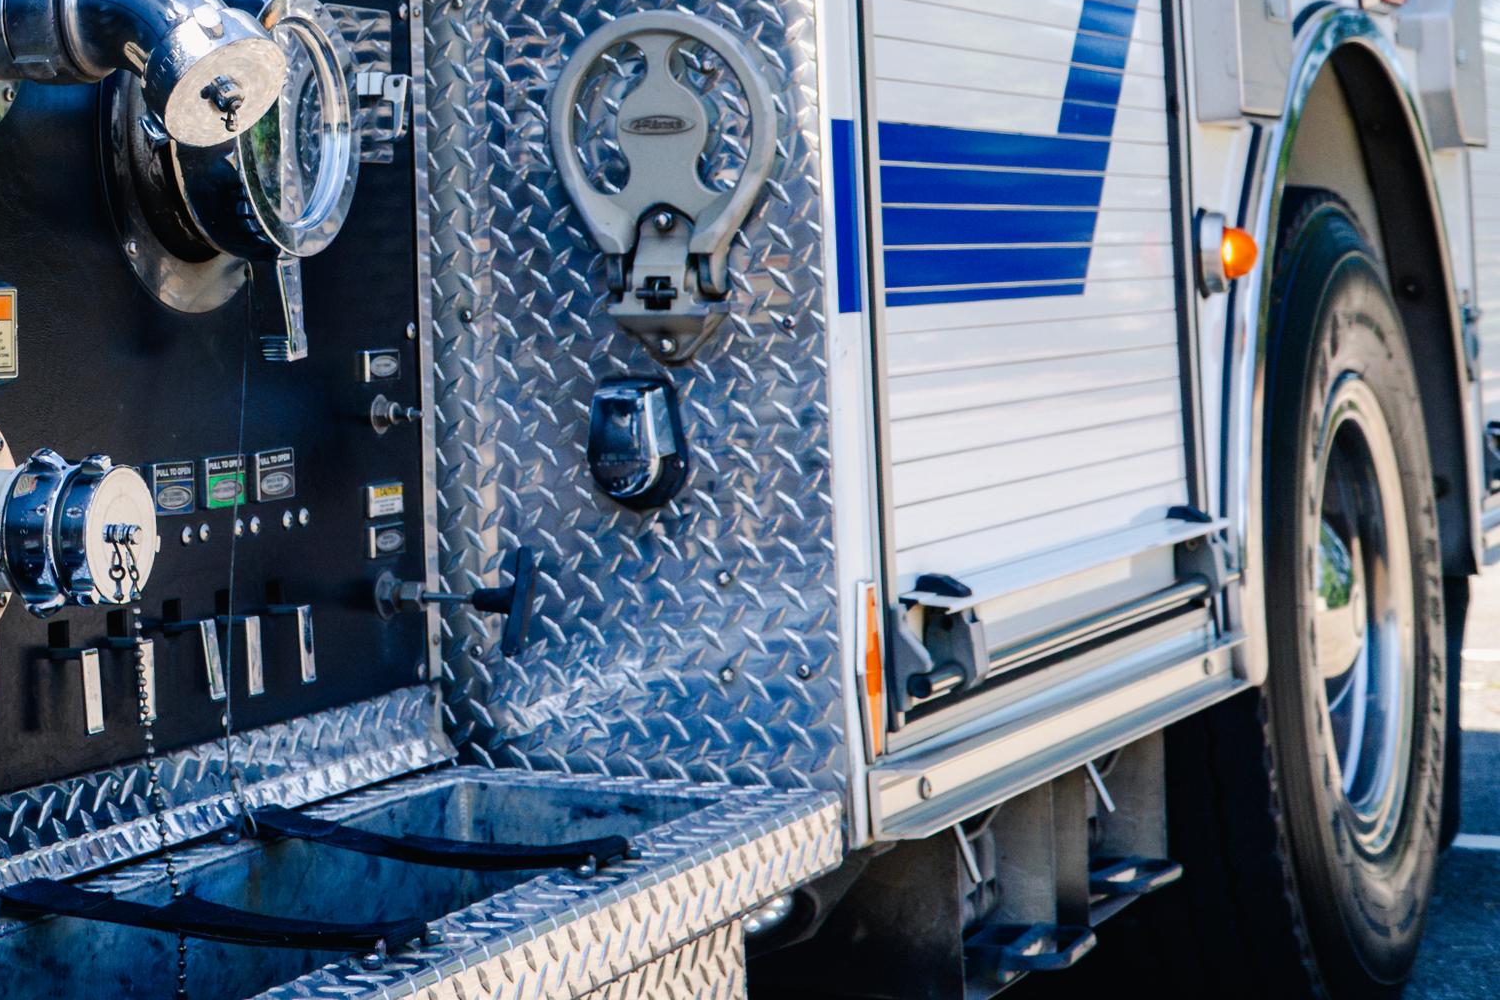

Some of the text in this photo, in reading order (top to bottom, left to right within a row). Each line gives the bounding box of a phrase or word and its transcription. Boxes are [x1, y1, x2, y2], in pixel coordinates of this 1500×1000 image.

[270, 455, 277, 463] TO
[277, 453, 290, 462] OPEN
[156, 468, 169, 477] PULL
[177, 467, 191, 475] OPEN
